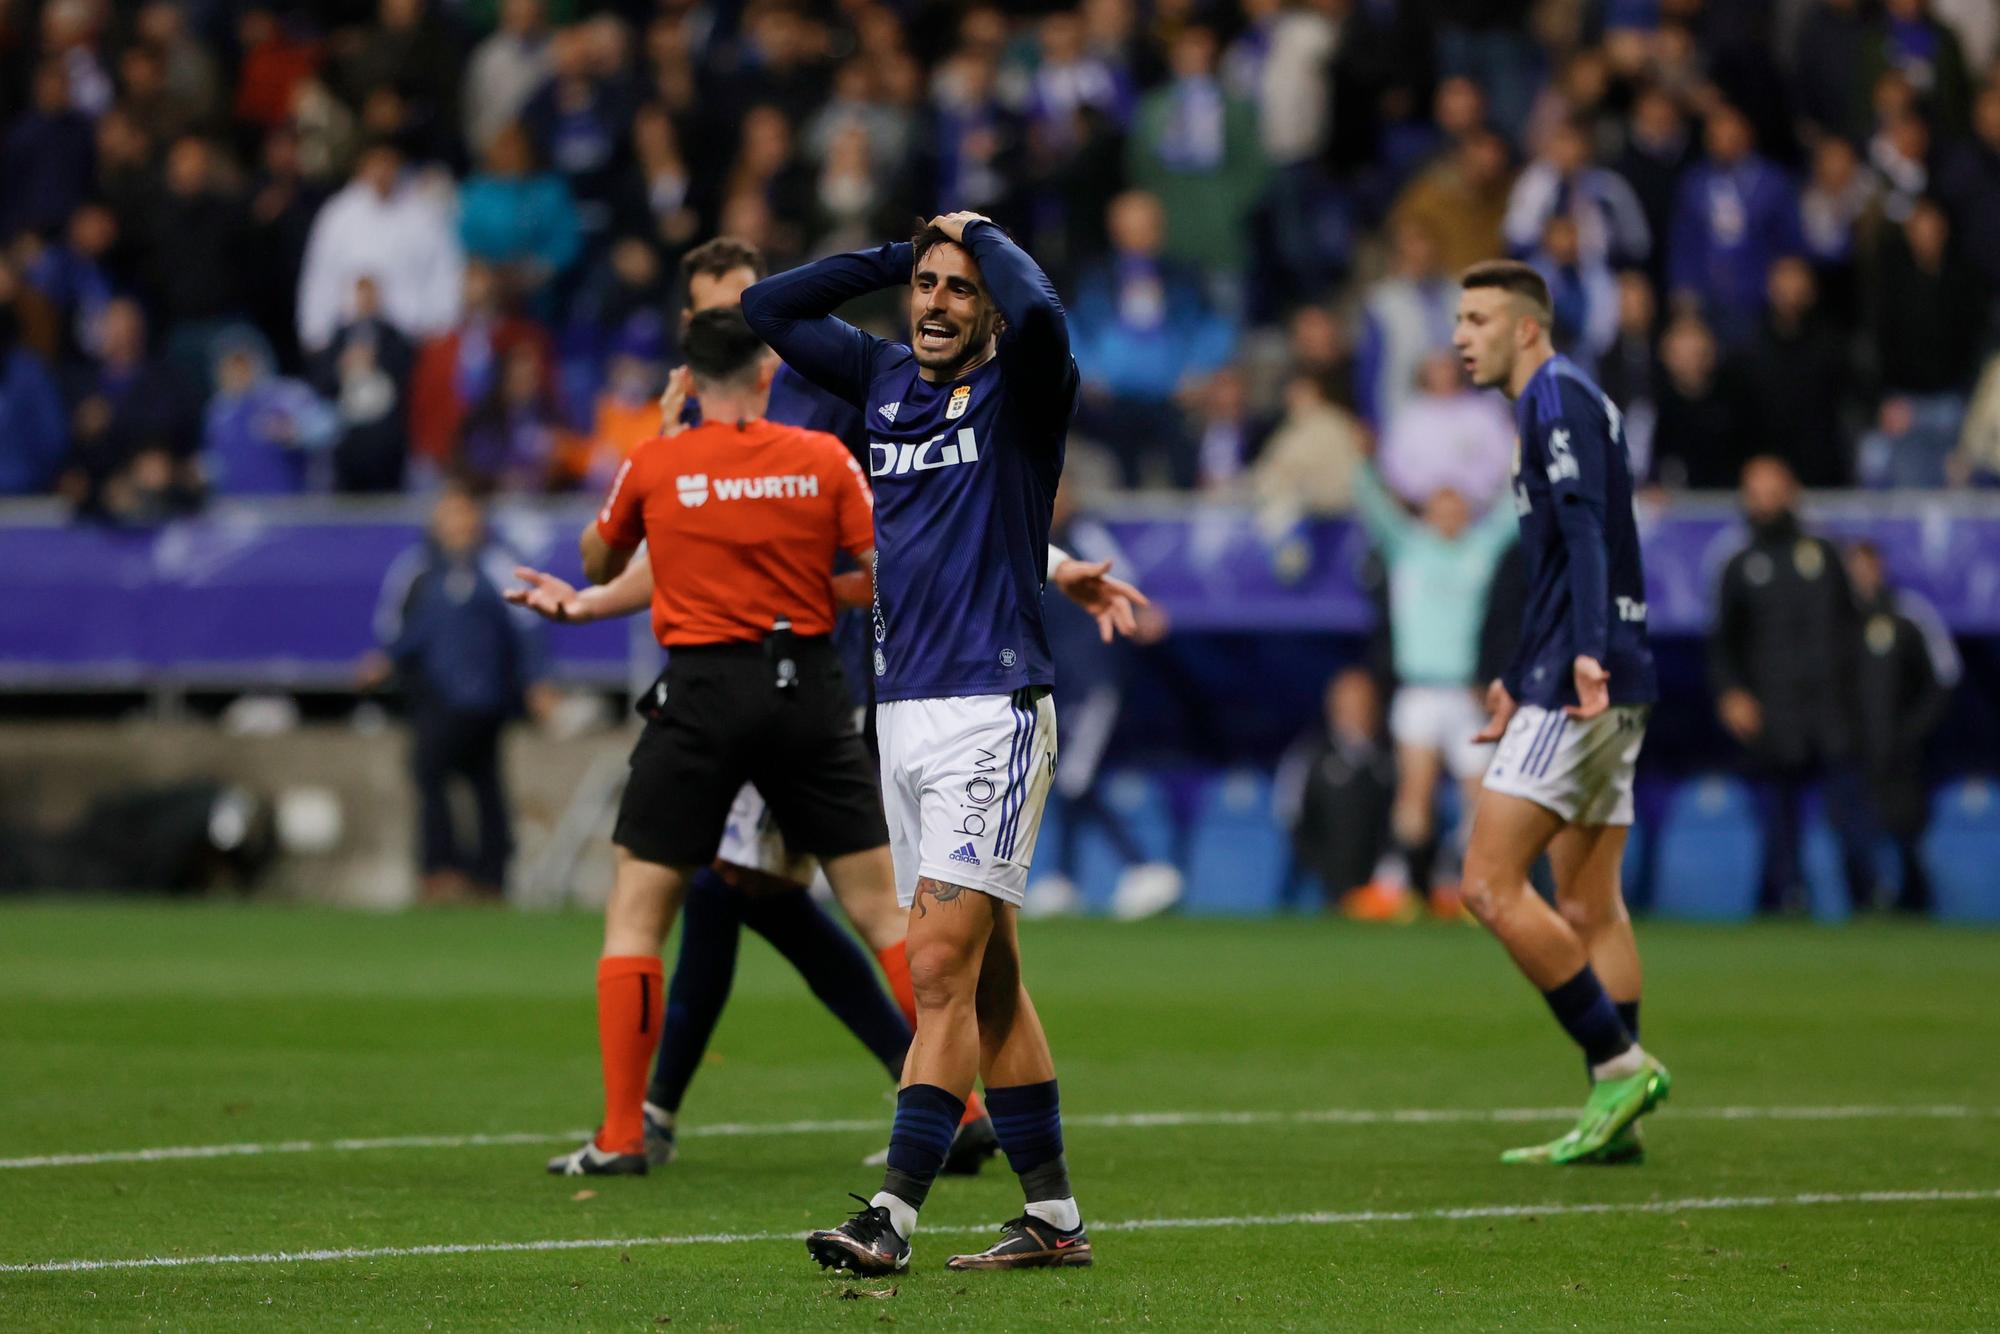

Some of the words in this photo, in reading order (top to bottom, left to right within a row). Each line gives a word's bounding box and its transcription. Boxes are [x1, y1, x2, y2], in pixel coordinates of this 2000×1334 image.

[870, 427, 978, 477] DIGI
[953, 748, 997, 838] biow
[948, 853, 980, 865] adidas
